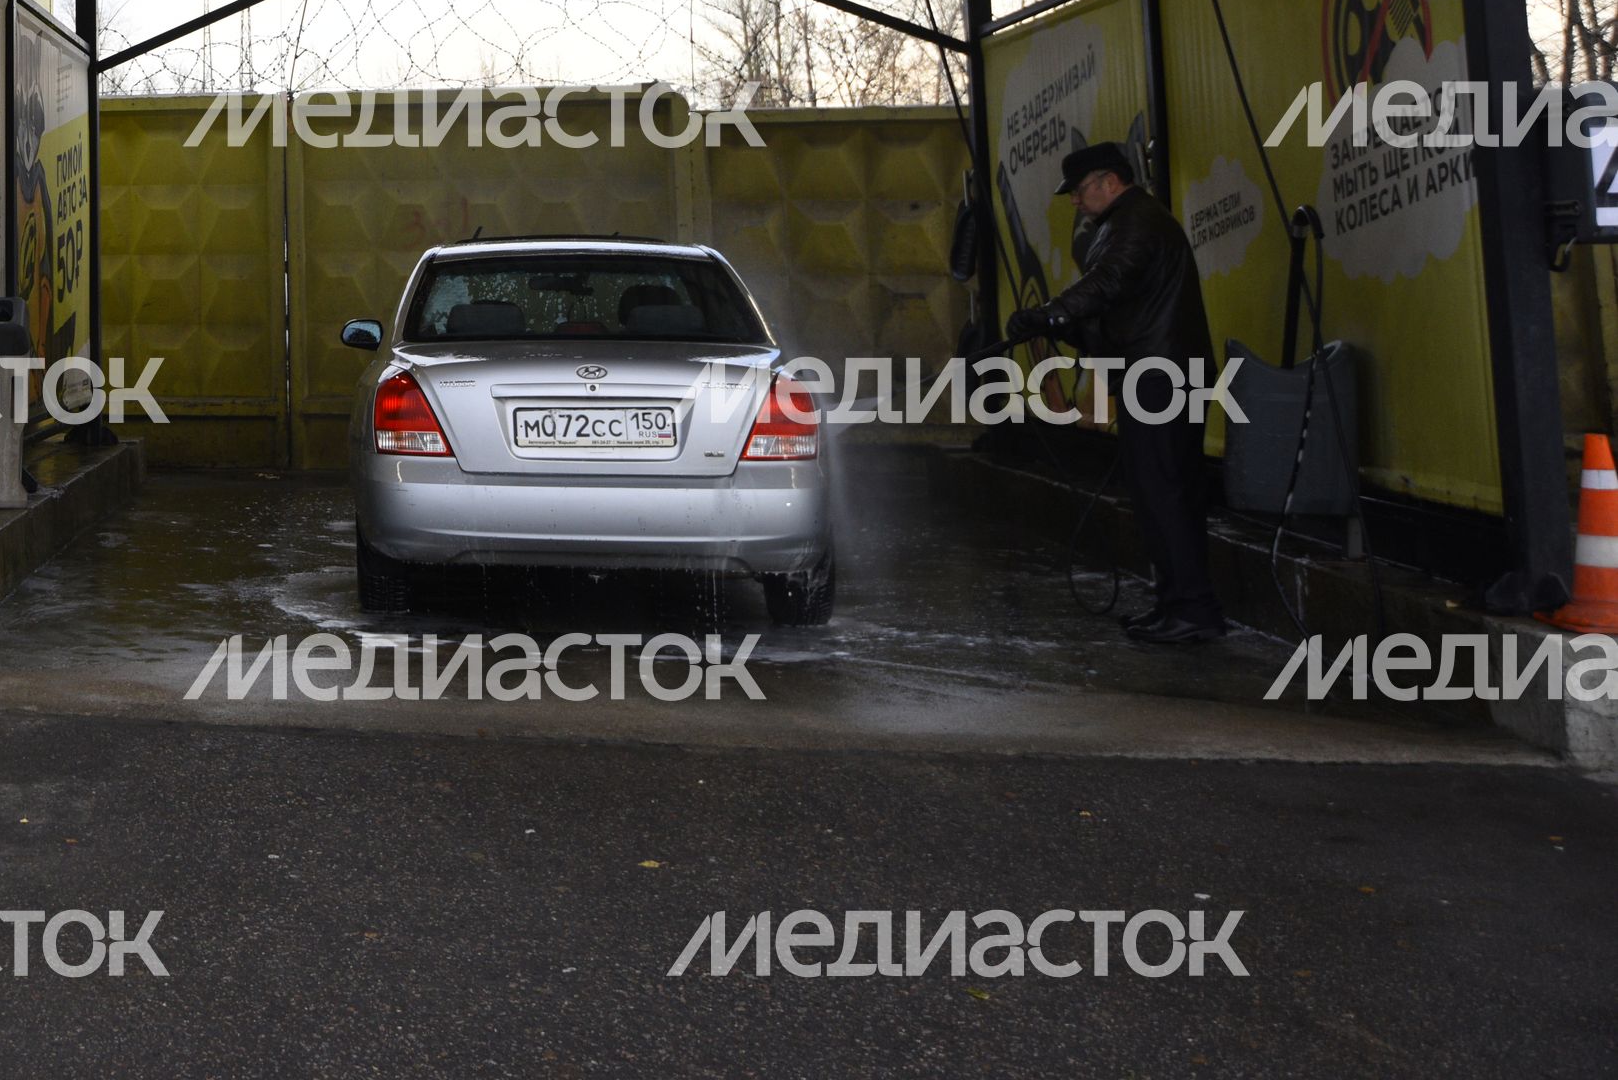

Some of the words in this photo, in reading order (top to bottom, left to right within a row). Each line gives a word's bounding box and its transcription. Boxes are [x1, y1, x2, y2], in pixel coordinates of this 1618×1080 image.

[1007, 111, 1020, 140] НЕ
[1021, 42, 1095, 129] ЗАДЕРЖИВАЙ
[56, 132, 83, 187] ПОМОЙ
[1009, 114, 1067, 175] ОЧЕРЕДЬ
[1333, 162, 1378, 202] МЫТЬ
[1334, 184, 1403, 236] КОЛЕСА
[1408, 177, 1419, 206] И
[630, 412, 666, 430] 150
